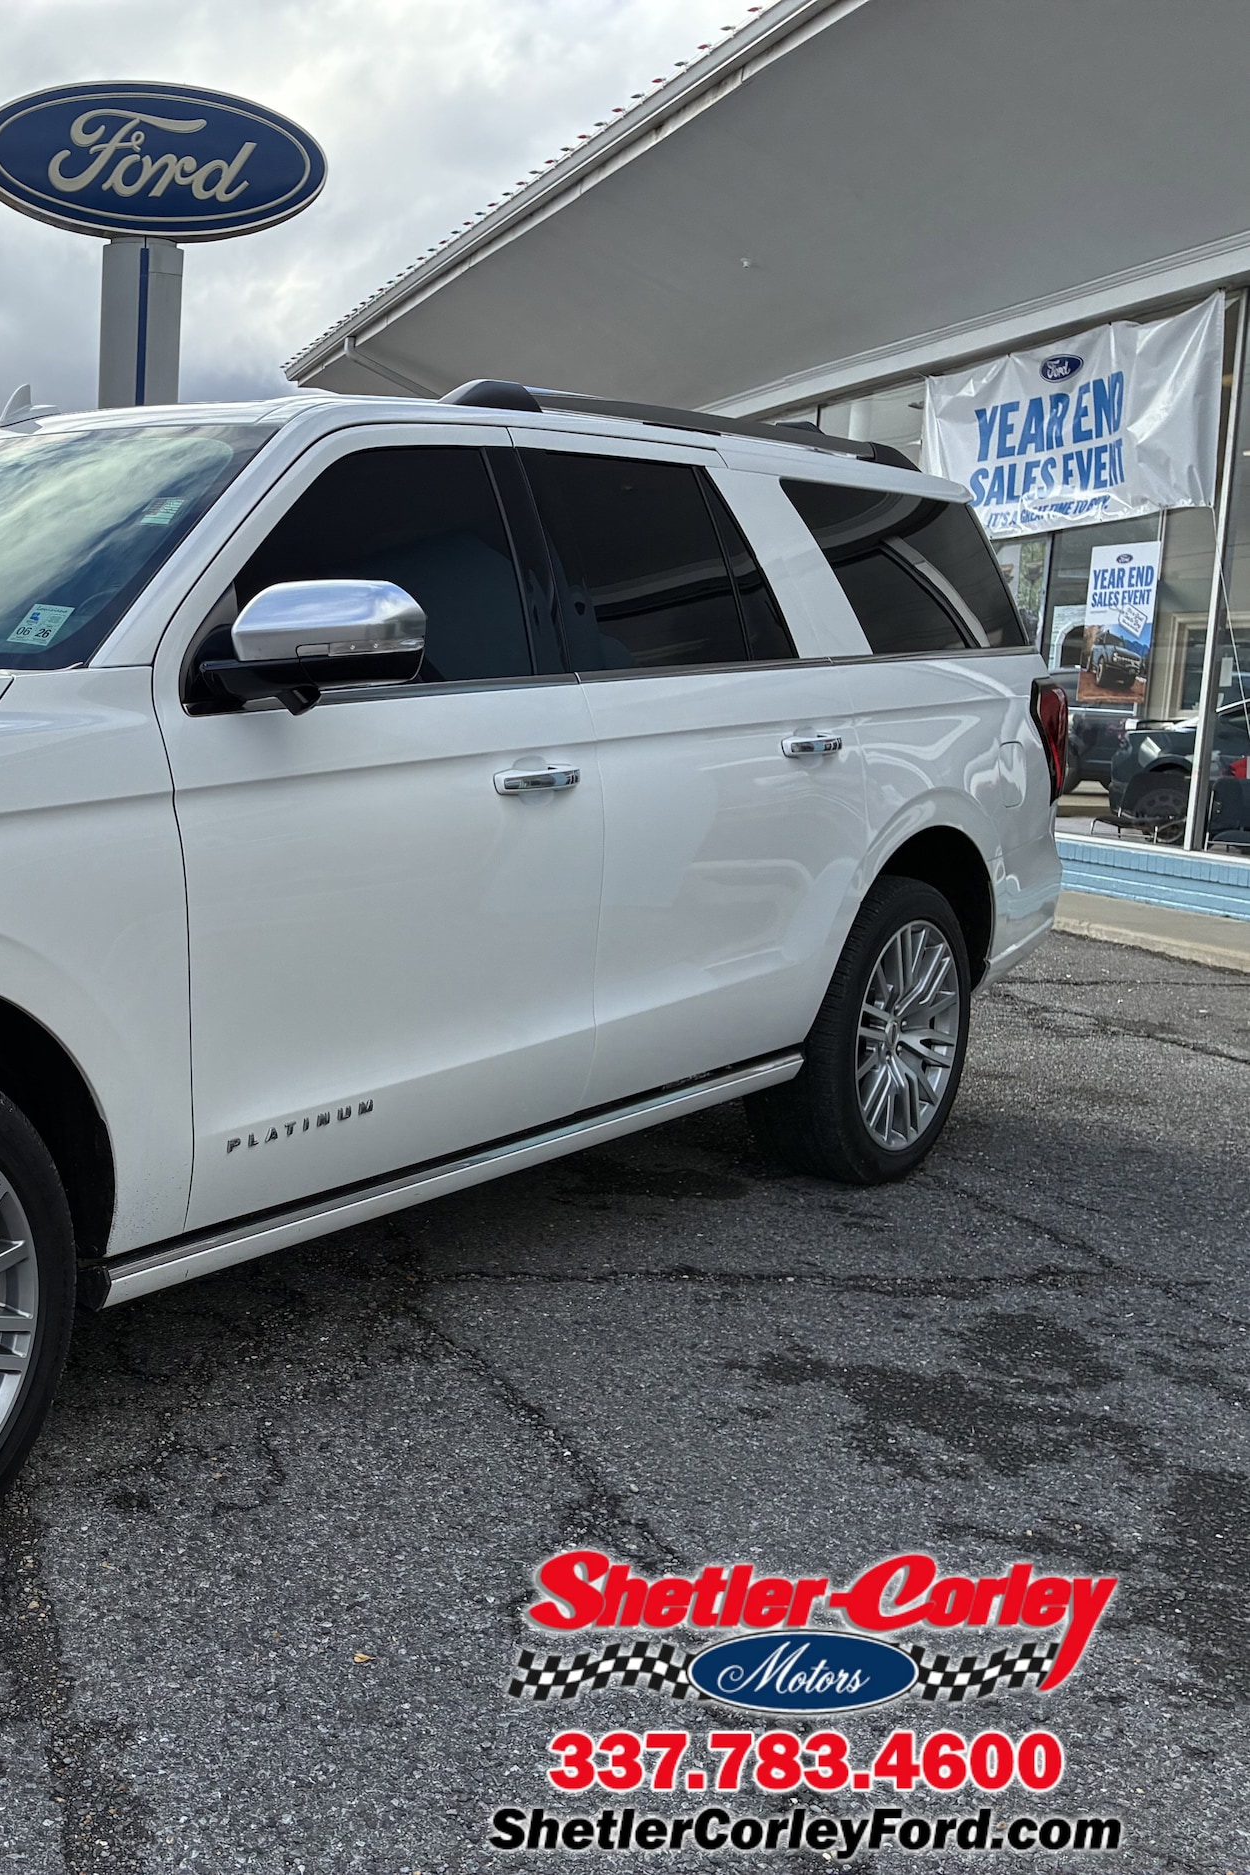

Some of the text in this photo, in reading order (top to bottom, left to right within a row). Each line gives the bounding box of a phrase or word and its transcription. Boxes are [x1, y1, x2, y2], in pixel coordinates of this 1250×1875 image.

[48, 109, 257, 203] Ford
[1047, 359, 1071, 378] Ford
[974, 371, 1125, 463] YEAR END
[969, 438, 1125, 508] SALES EVENT
[1093, 565, 1155, 590] YEAR END
[1091, 588, 1152, 608] SALES EVENT
[16, 626, 33, 636] 06
[35, 628, 52, 639] 26
[226, 1099, 374, 1154] PLATINUM
